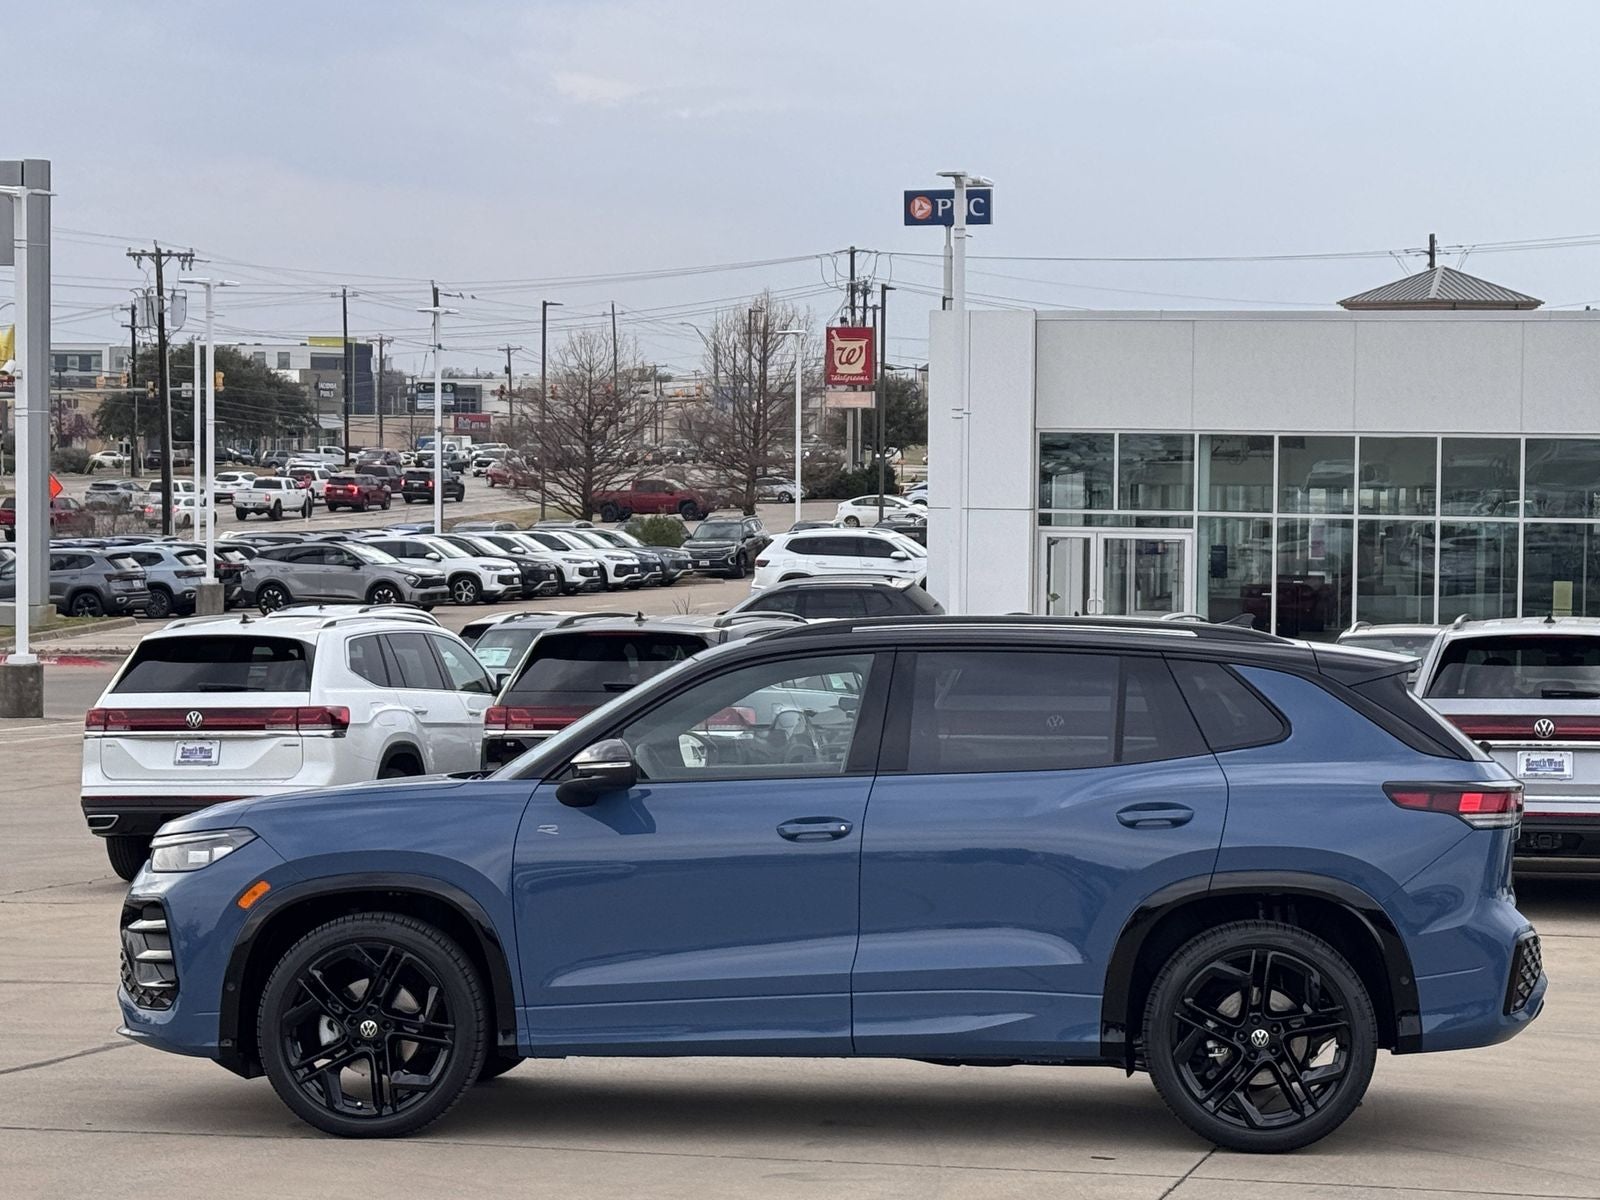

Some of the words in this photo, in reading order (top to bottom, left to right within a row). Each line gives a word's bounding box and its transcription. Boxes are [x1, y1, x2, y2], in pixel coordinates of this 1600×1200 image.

[935, 197, 985, 217] PC
[836, 344, 864, 366] W
[830, 374, 870, 384] Walgreens
[186, 711, 202, 728] VW
[1534, 719, 1554, 738] VW
[360, 1019, 378, 1038] VW
[1250, 1029, 1270, 1048] VW
